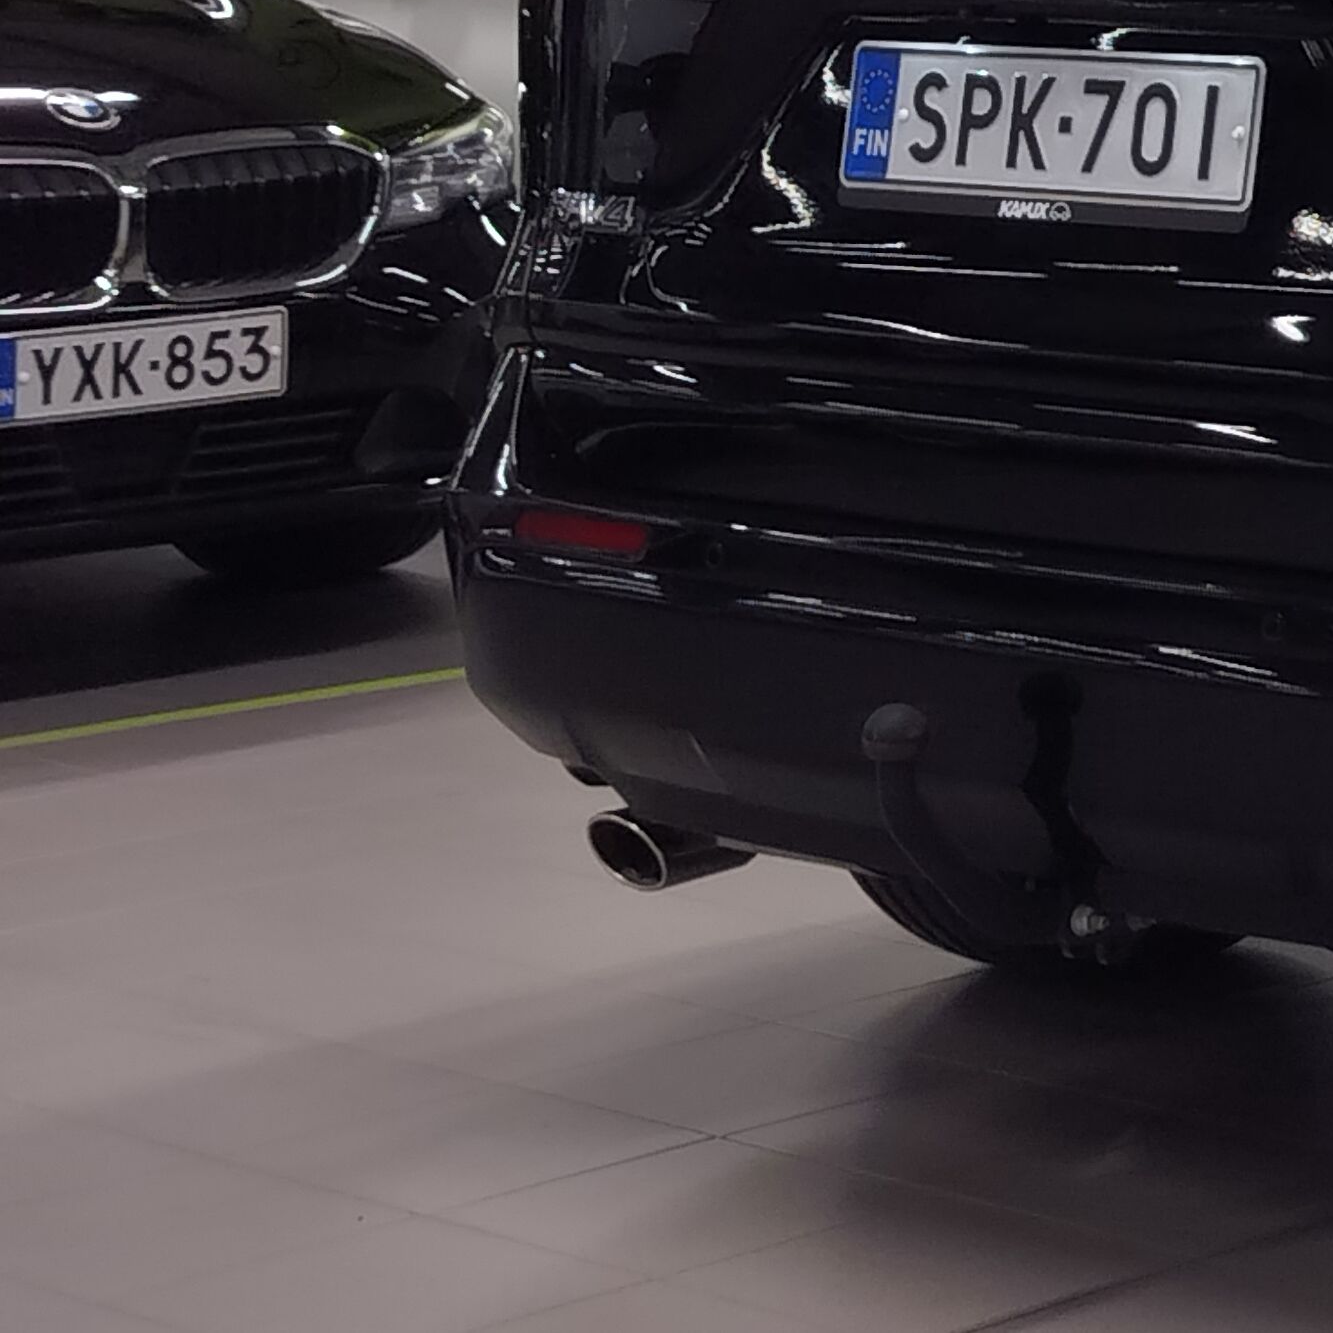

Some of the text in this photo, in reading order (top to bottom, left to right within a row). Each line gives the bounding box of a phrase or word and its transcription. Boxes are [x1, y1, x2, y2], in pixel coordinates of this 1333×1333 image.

[851, 126, 889, 158] FIN
[907, 70, 1216, 181] SPK-701
[996, 199, 1051, 221] KAMUX
[31, 326, 272, 408] YXK-853
